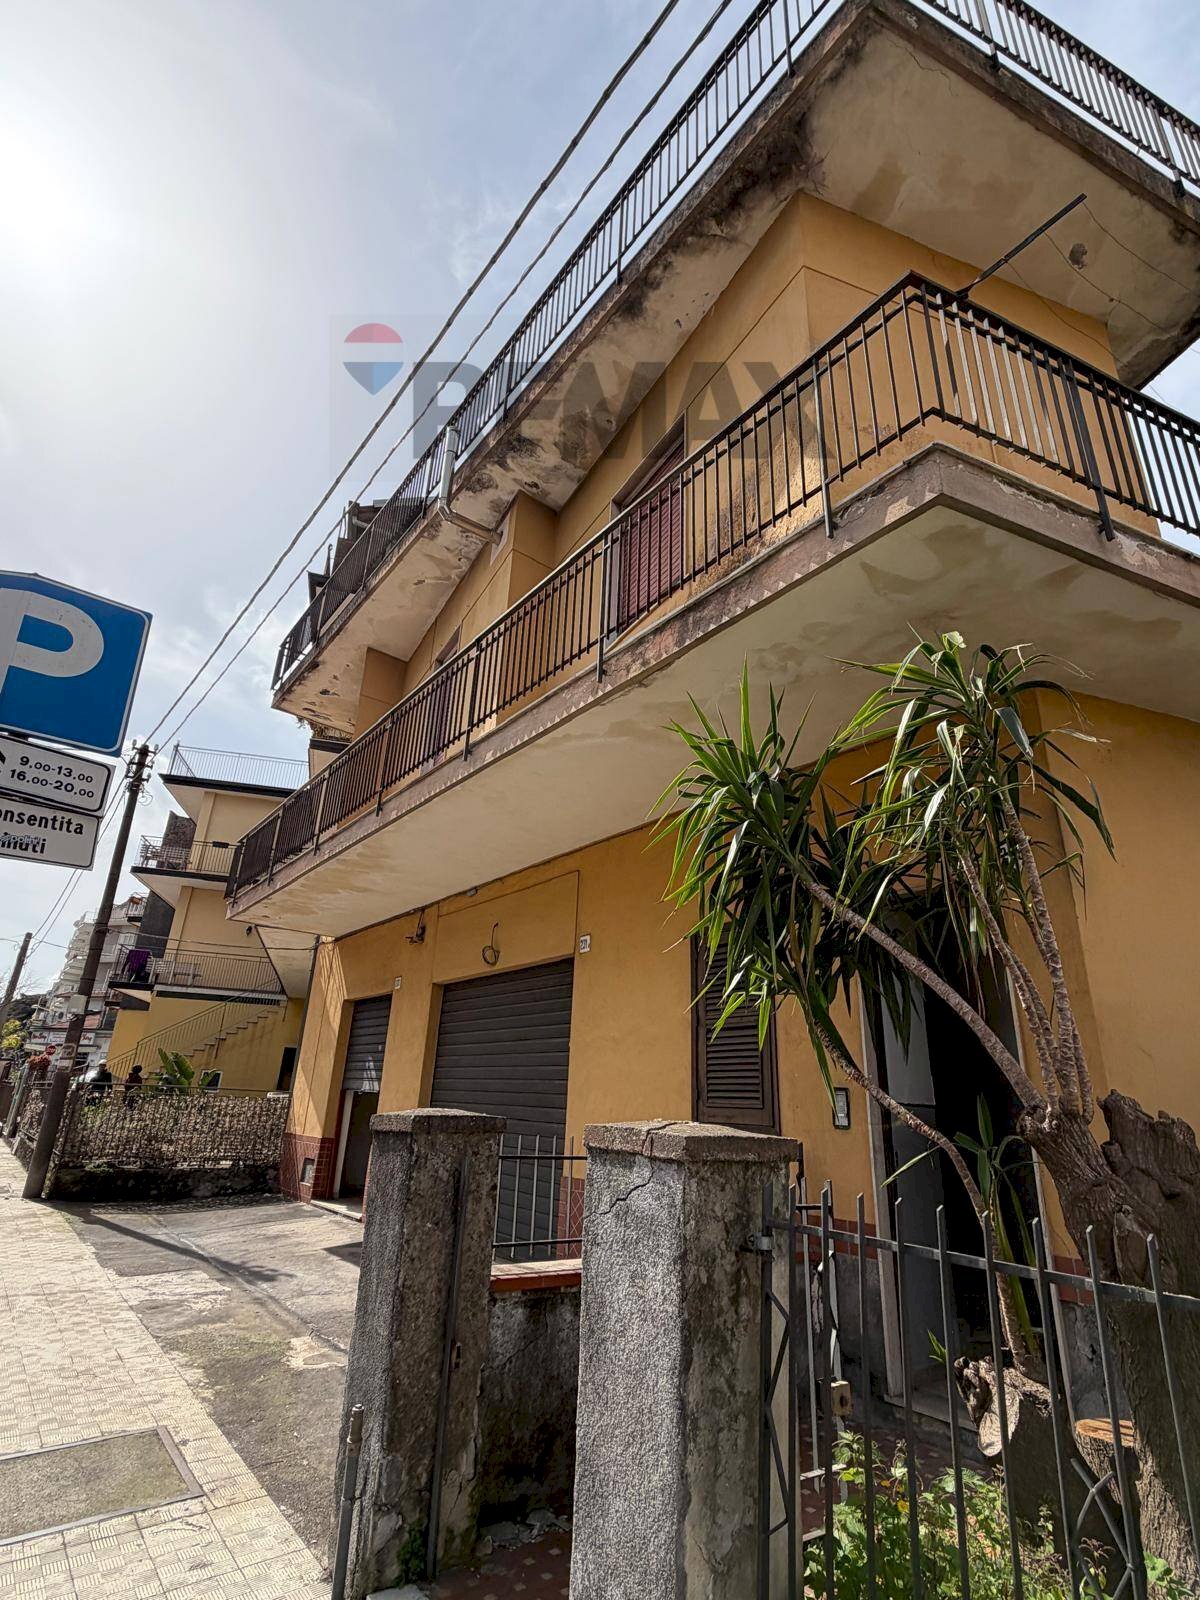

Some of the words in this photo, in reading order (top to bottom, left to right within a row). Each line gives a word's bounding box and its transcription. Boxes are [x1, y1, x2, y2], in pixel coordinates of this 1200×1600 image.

[0, 587, 104, 697] P
[19, 755, 94, 784] 9.00-13.00
[0, 808, 84, 836] nsentita
